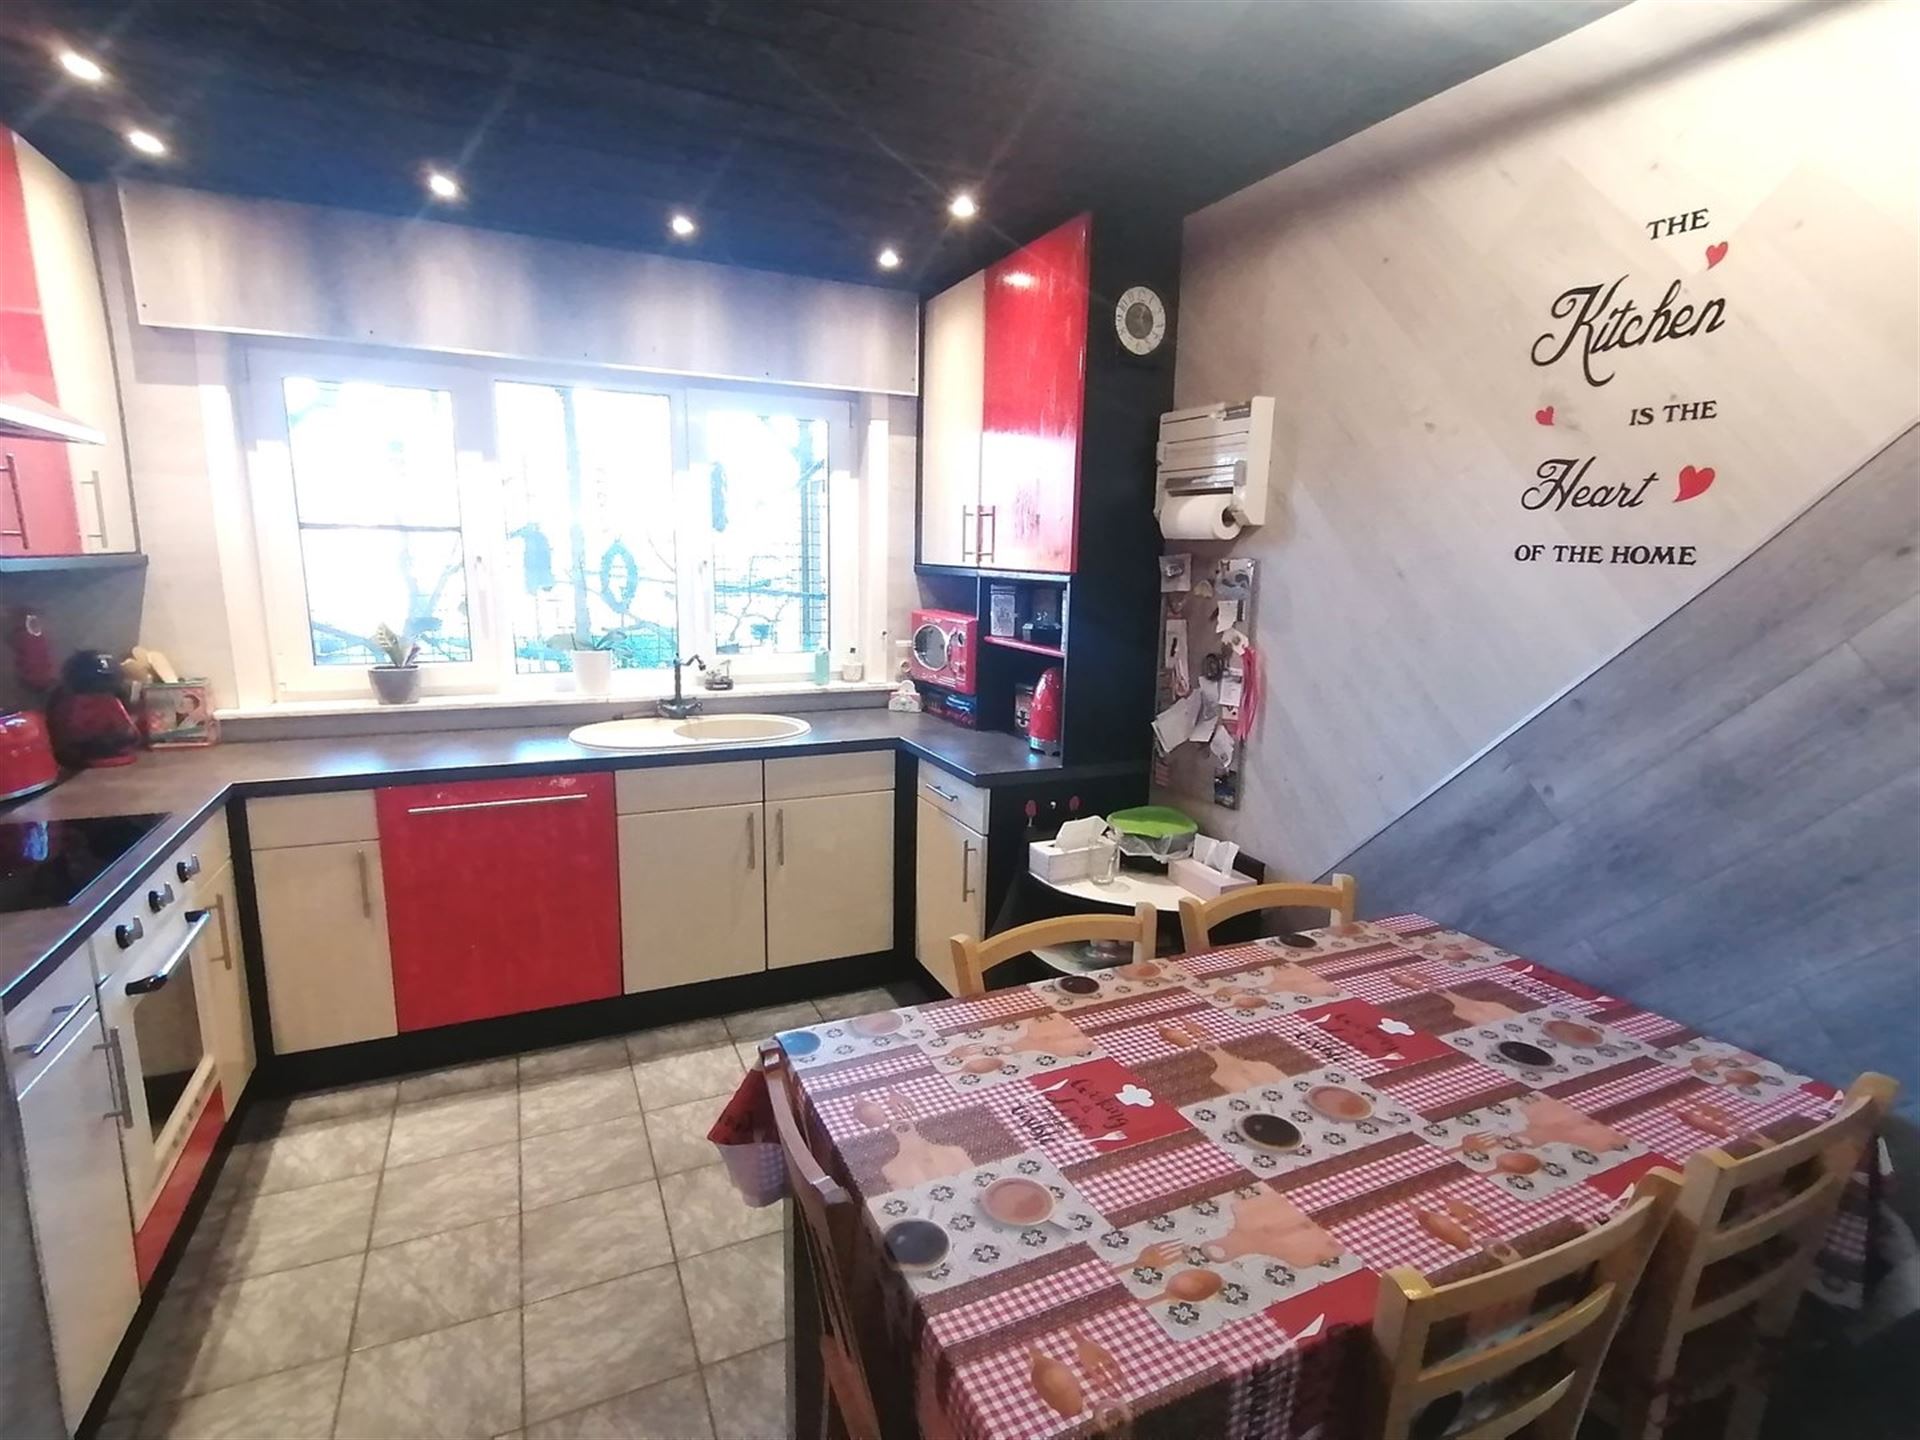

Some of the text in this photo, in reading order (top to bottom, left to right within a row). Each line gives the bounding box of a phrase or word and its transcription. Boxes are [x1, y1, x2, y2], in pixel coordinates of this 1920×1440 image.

[1645, 207, 1711, 241] THE
[1530, 274, 1726, 388] Kitchen
[1628, 399, 1718, 427] IS THE
[1520, 455, 1660, 513] Heart
[1513, 544, 1697, 567] OF THE HOME
